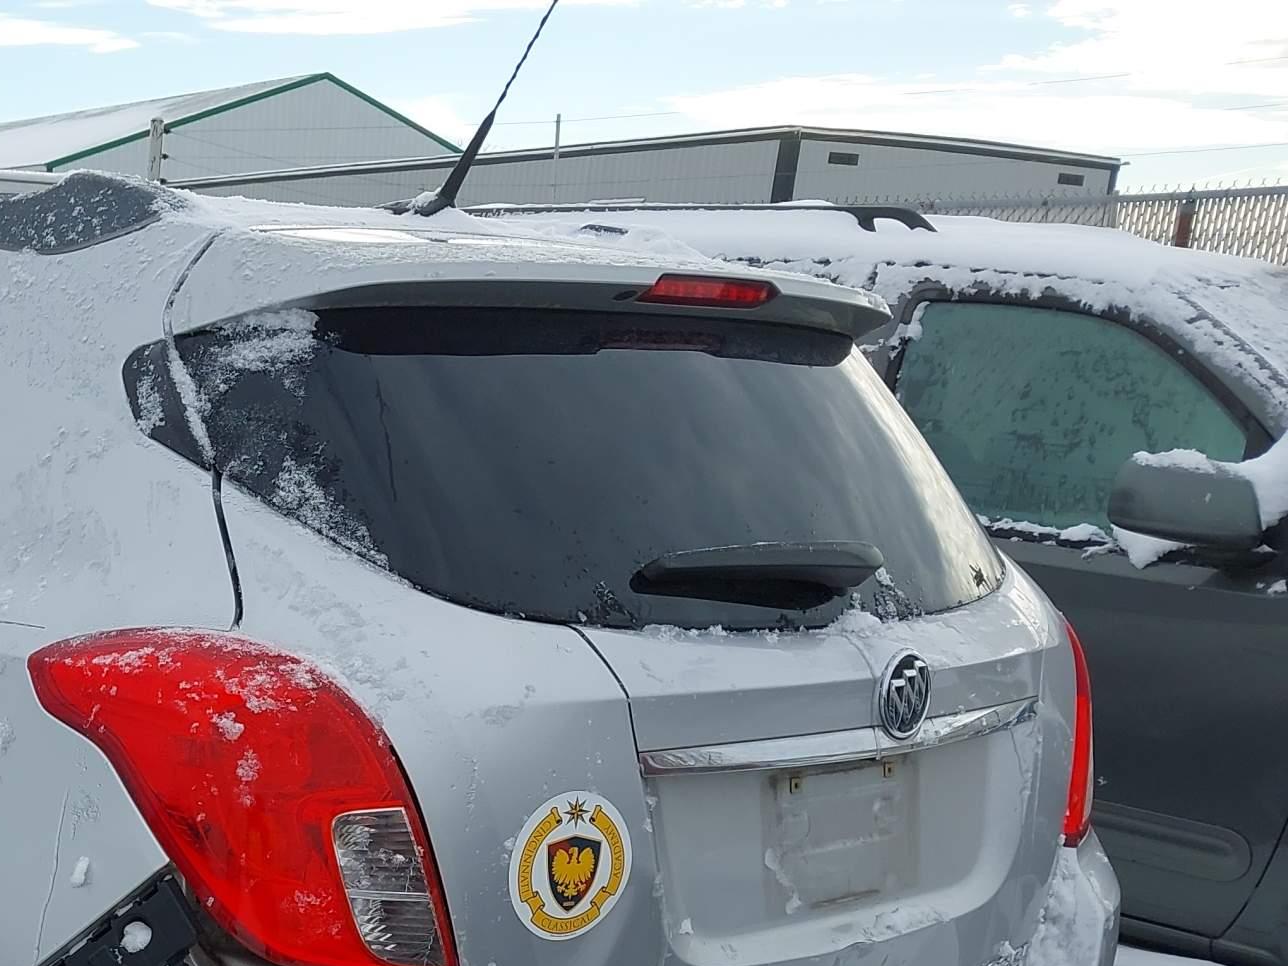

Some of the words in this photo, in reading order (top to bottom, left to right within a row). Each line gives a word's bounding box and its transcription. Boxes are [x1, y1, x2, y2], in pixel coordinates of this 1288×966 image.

[520, 820, 552, 894] CINCINNATI
[540, 913, 592, 932] CLASSICAL
[605, 824, 624, 881] ACADEMY
